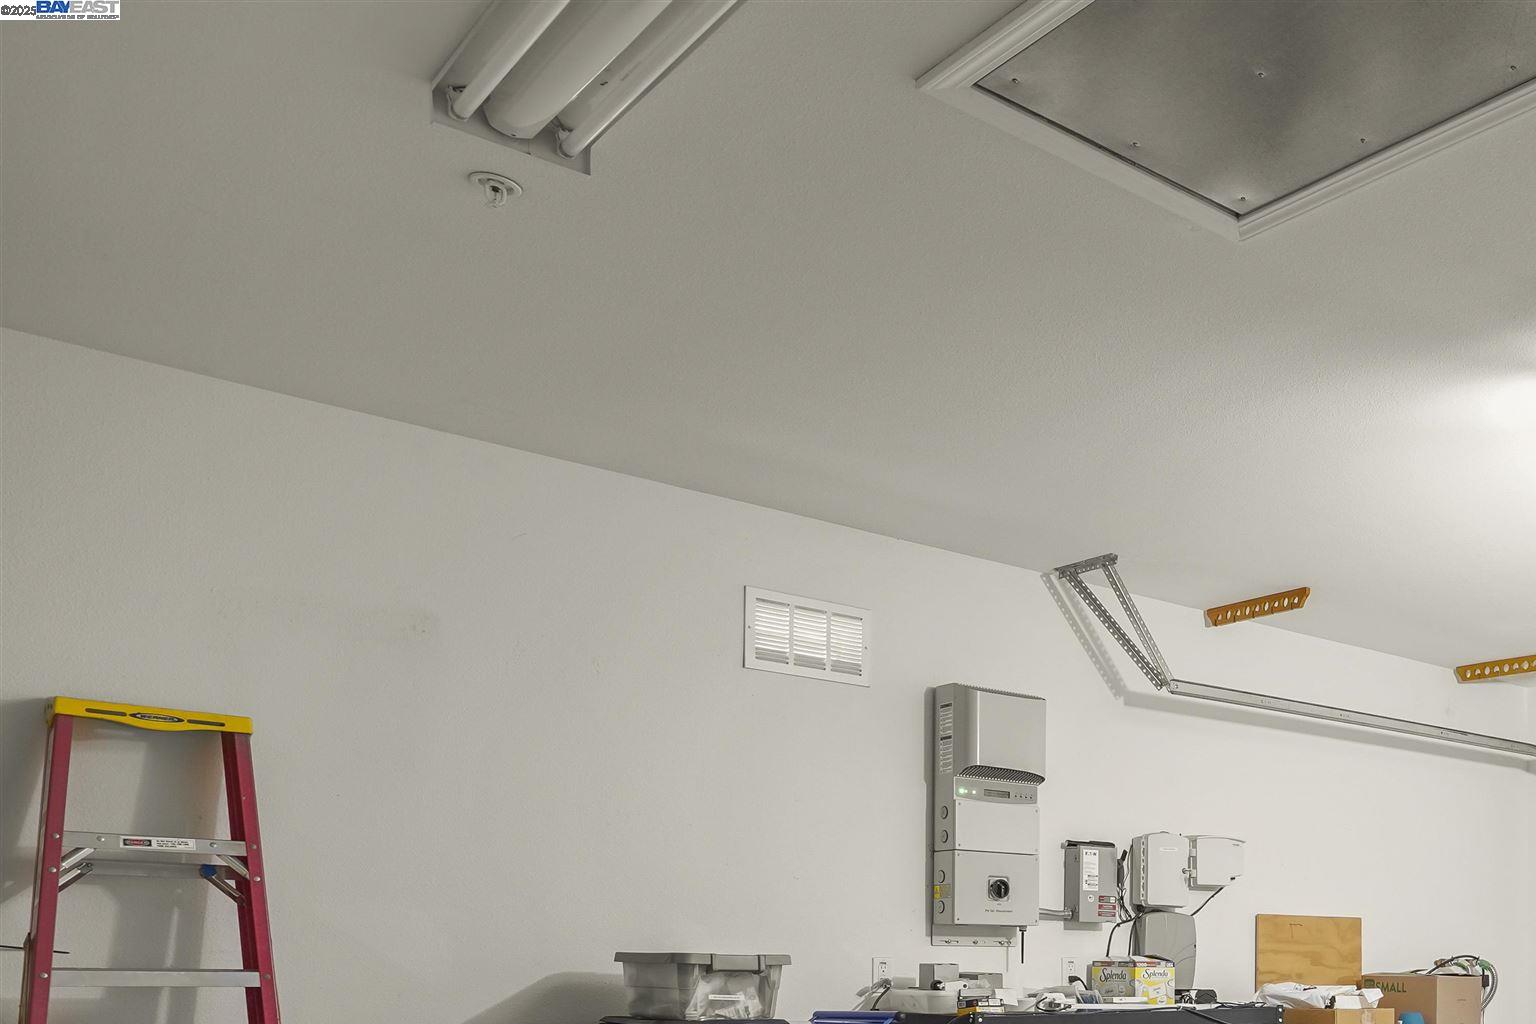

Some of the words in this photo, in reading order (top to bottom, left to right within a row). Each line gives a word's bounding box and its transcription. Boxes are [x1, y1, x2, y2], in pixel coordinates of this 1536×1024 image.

[1100, 967, 1127, 983] Splenda
[1143, 968, 1169, 982] Splenda
[1376, 981, 1407, 993] SMALL
